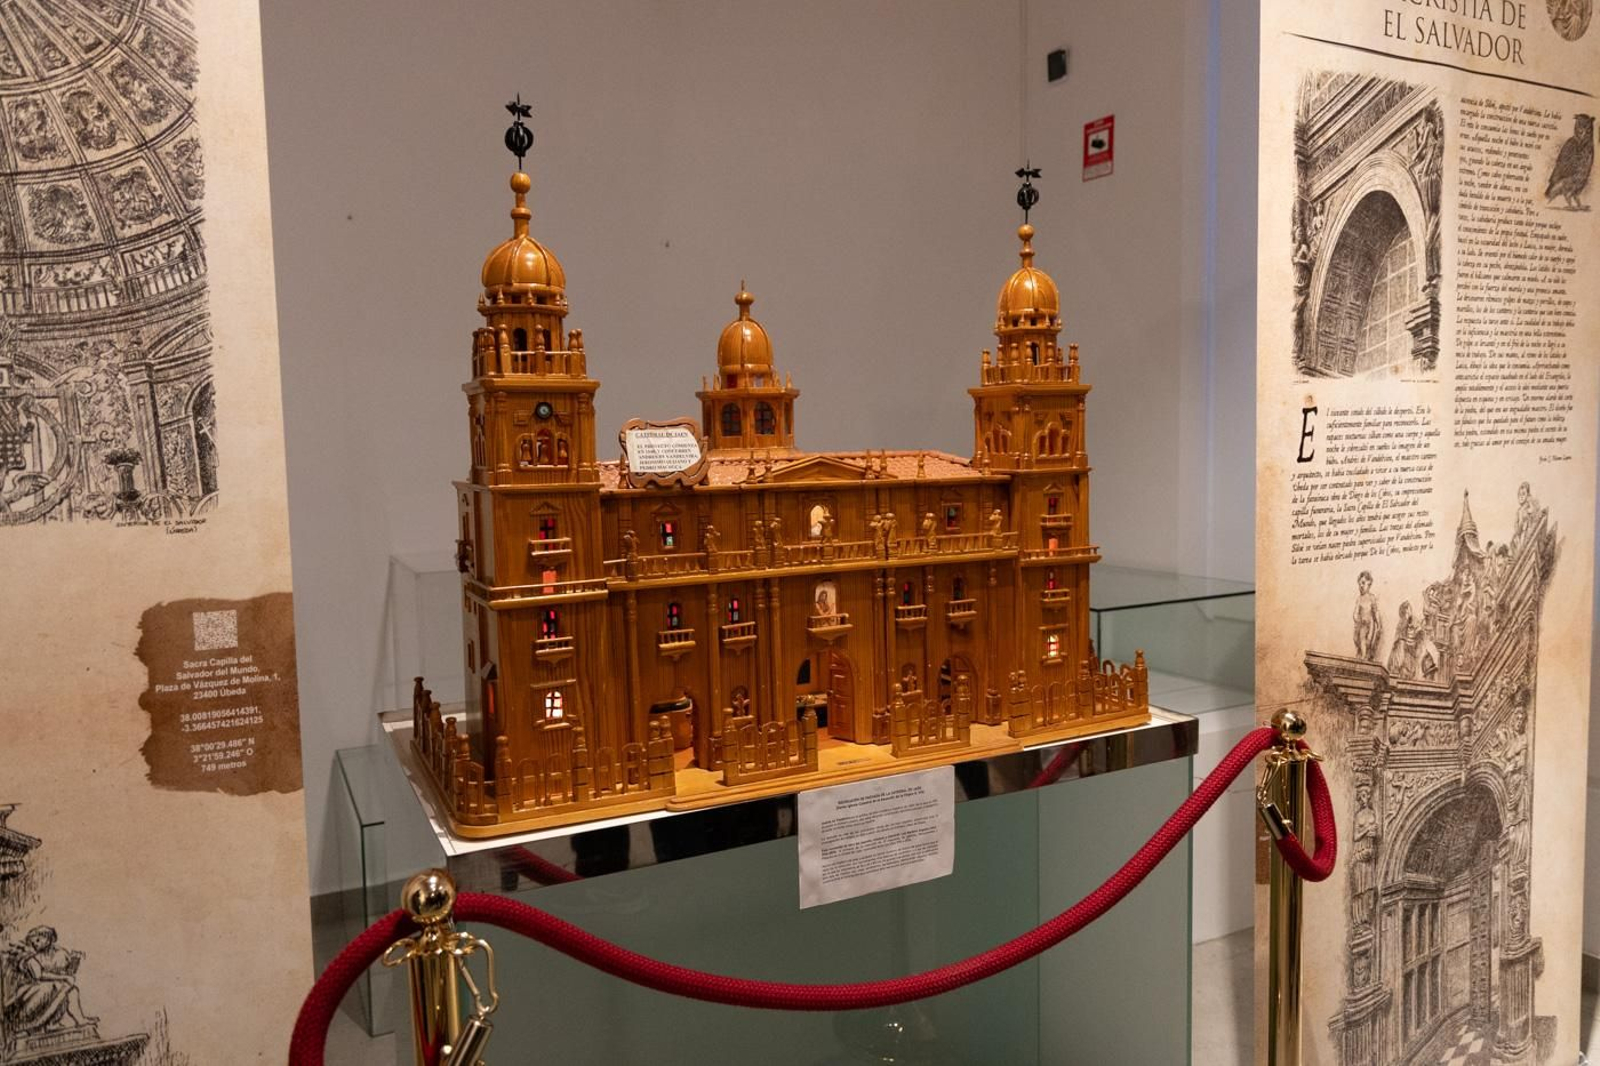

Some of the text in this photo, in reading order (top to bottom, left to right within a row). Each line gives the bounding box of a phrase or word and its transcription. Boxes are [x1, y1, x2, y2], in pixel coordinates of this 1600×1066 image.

[1502, 0, 1526, 30] DE
[1383, 9, 1525, 65] EL SALVADOR
[183, 655, 252, 669] Sacra Capilla del
[176, 671, 213, 680] Salvador
[215, 668, 228, 676] del
[155, 684, 179, 693] Plaza
[180, 682, 191, 690] de
[193, 678, 228, 690] Vázquez
[230, 676, 240, 685] de
[193, 687, 246, 700] 23400 Úbeda
[201, 760, 246, 772] 749 metros
